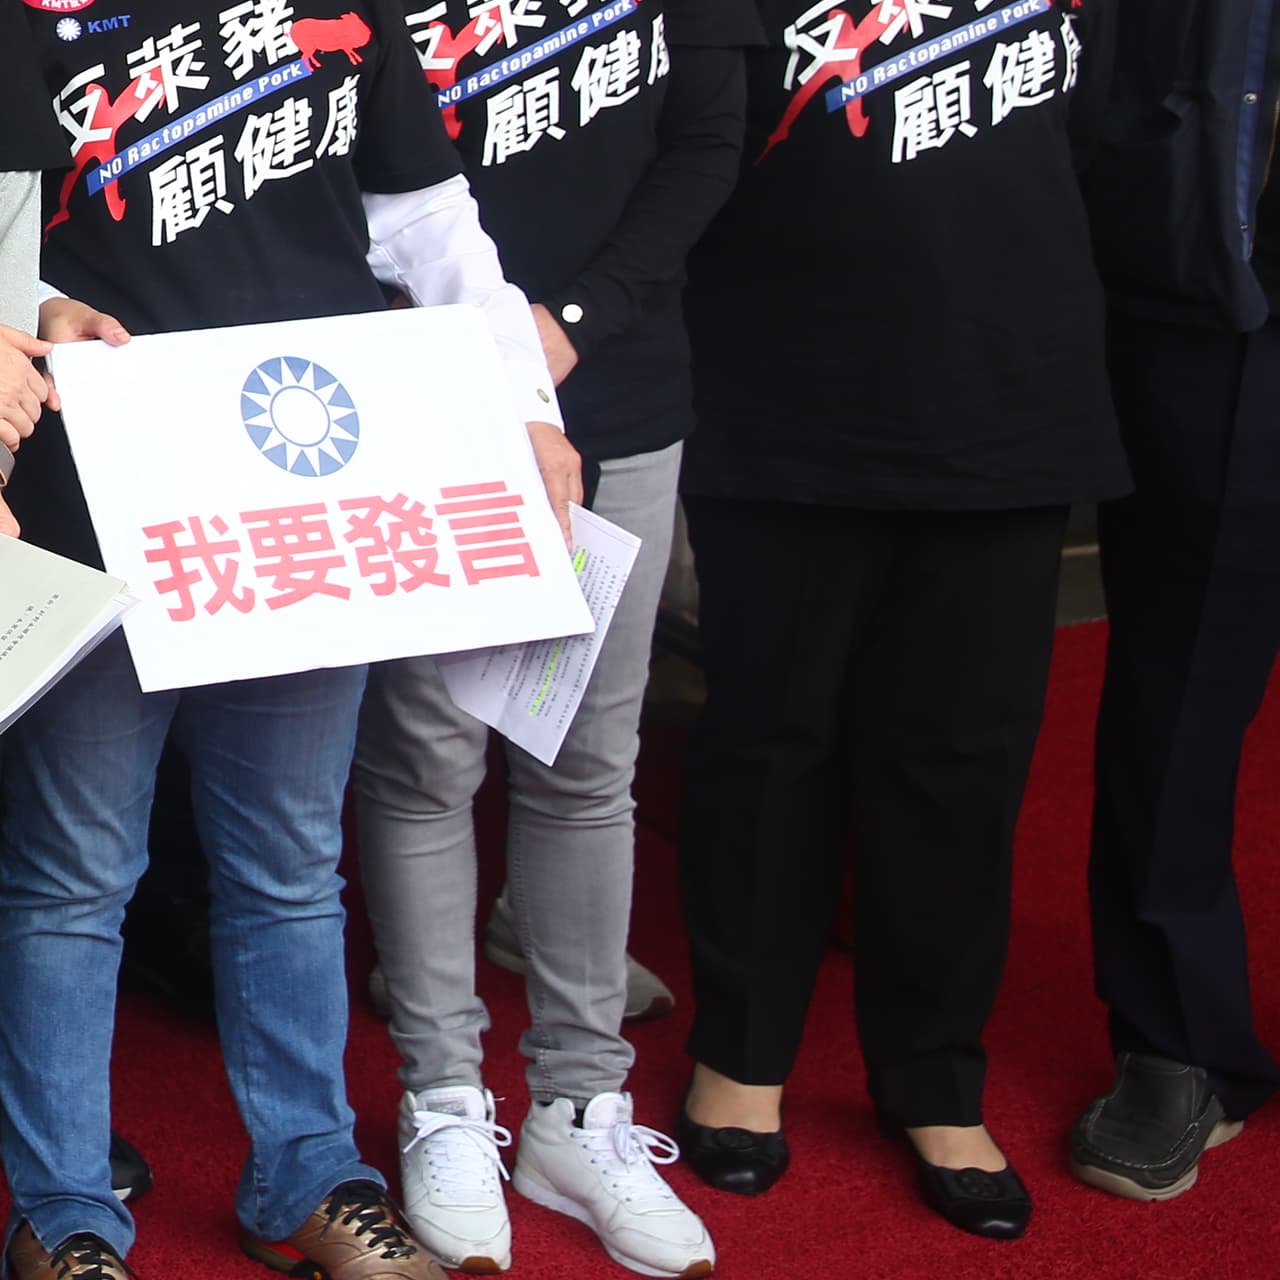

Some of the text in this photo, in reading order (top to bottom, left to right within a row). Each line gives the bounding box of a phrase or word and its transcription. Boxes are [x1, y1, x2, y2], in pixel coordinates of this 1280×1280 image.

[88, 14, 131, 34] KMT
[437, 85, 462, 108] NO
[466, 21, 589, 93] Ractopamine
[841, 77, 868, 102] NO
[873, 17, 998, 83] Ractopamine
[98, 62, 303, 184] NO Ractopamine Pork
[141, 480, 541, 623] 我要發言
